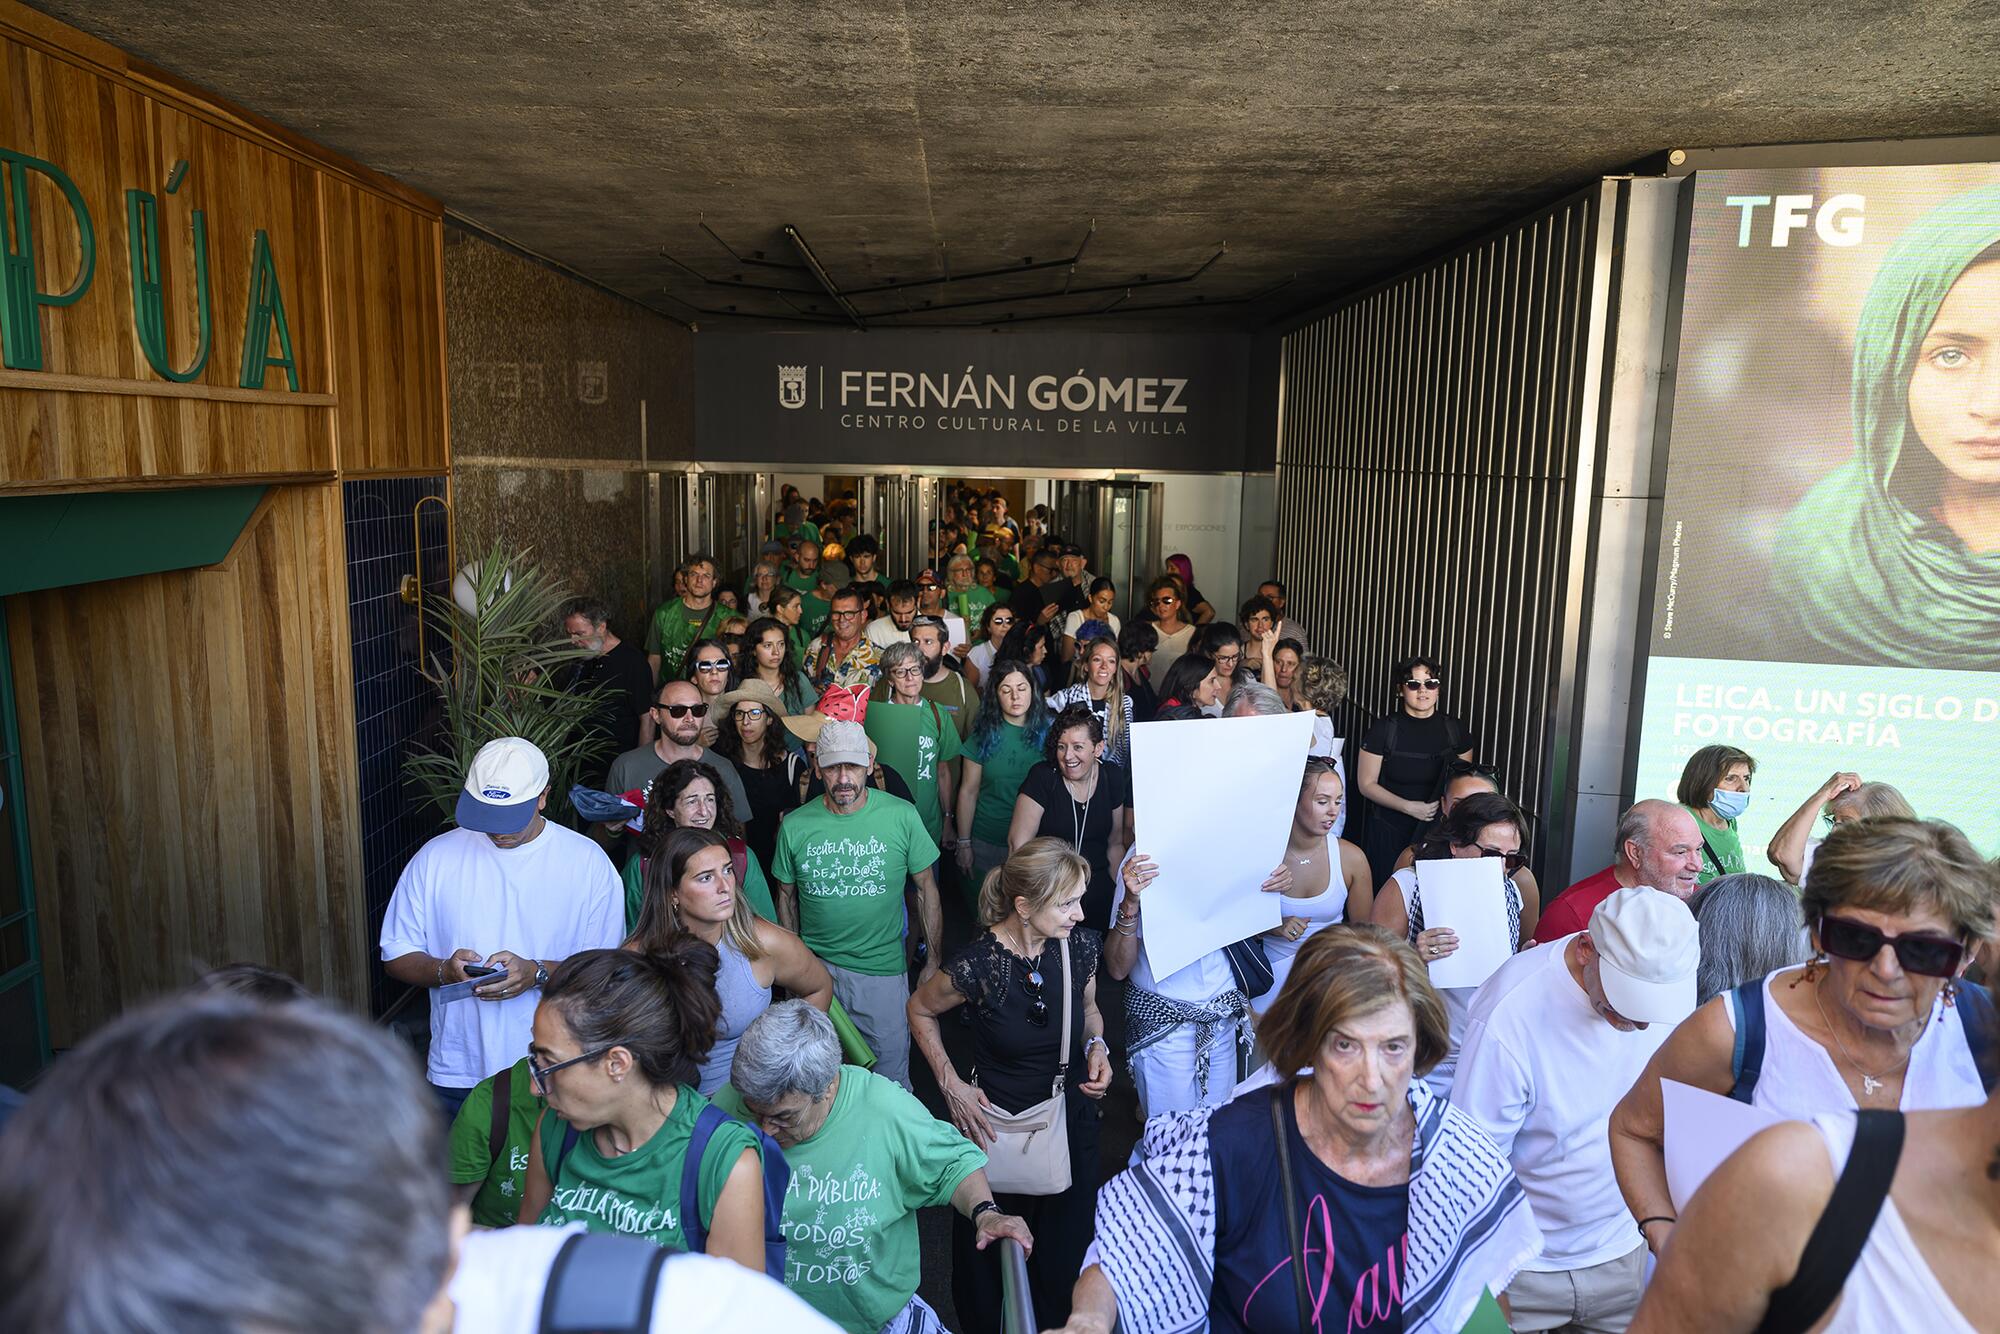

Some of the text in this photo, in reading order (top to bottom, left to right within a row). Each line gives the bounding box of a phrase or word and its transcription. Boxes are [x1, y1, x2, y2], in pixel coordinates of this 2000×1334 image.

[1726, 194, 1866, 248] TFG
[840, 365, 1189, 414] FERNÁN GÓMEZ
[840, 414, 1188, 436] CENTRO CULTURAL DE LA VILLA
[1676, 682, 1782, 712] LEICA.
[1793, 688, 1845, 716] UN
[1856, 691, 1963, 721] SIGLO
[1672, 712, 1901, 748] FOTOGRAFÍA
[806, 839, 888, 857] ESCUELA PÚBLICA:
[812, 865, 880, 878] DE TOD@S
[843, 884, 887, 897] TOD@S
[808, 1171, 881, 1206] PÚBLICA:
